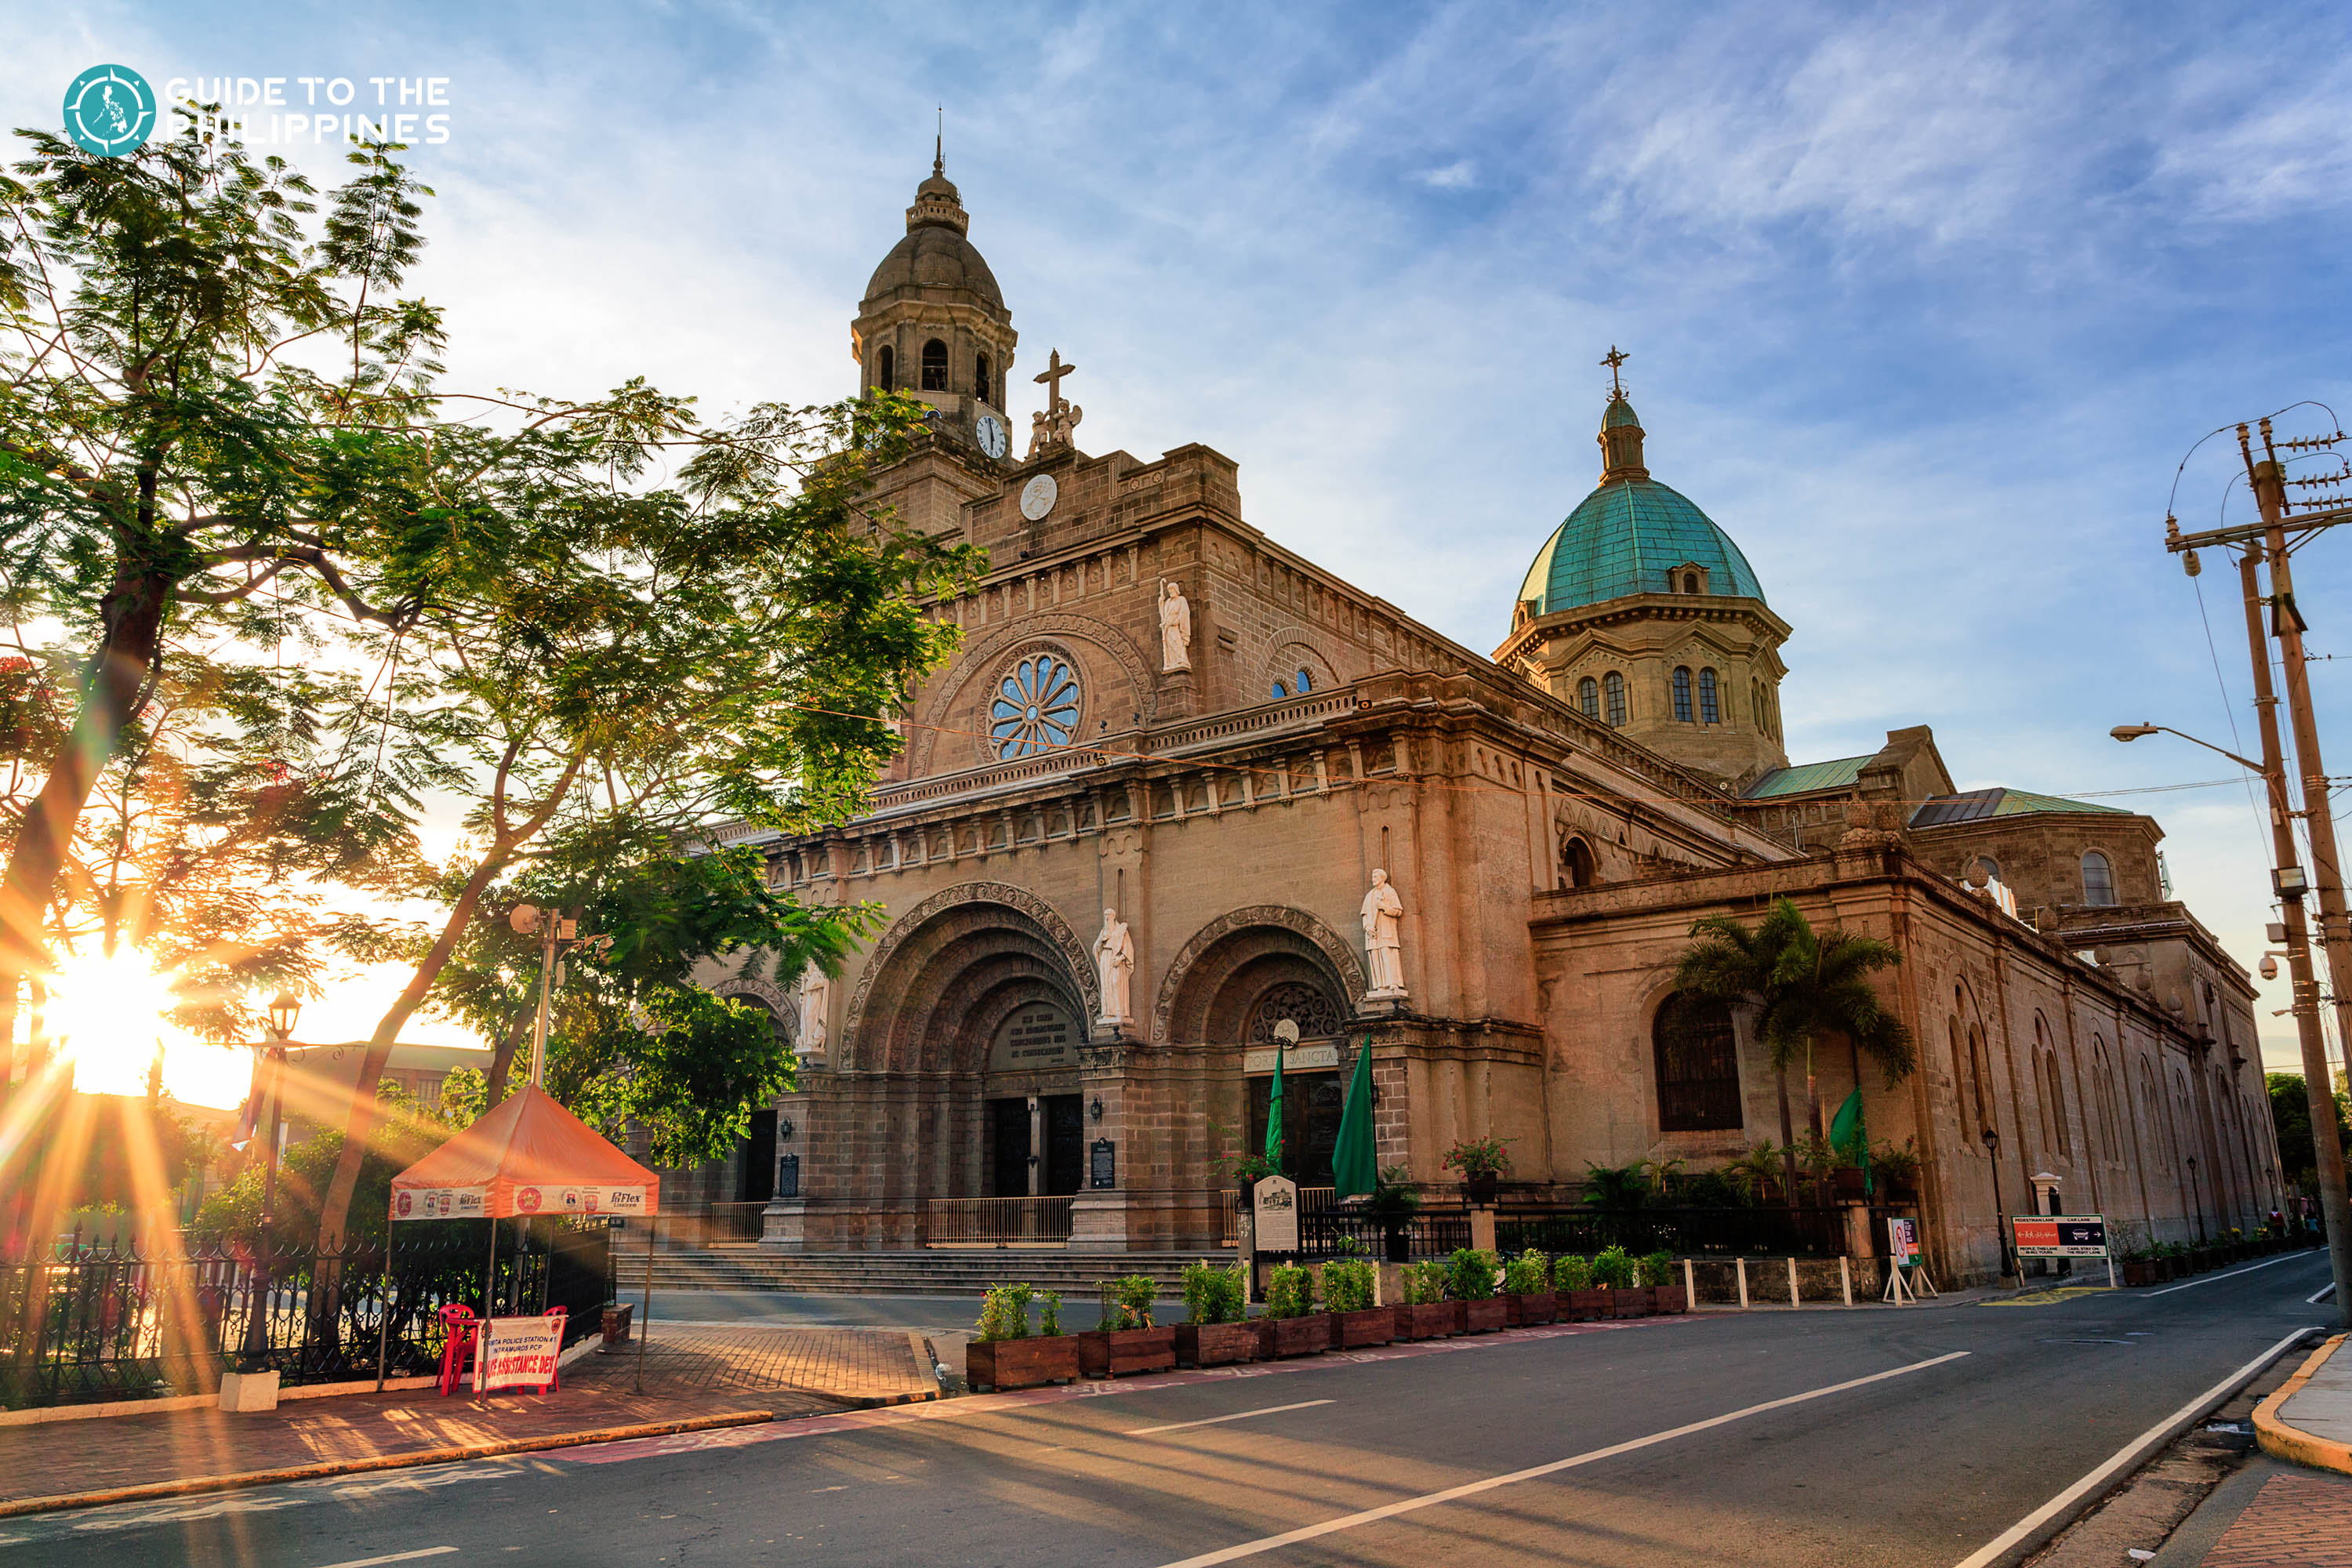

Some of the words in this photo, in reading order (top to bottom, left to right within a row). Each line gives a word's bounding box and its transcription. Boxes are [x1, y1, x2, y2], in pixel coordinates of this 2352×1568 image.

[1248, 1055, 1277, 1067] PORT
[1289, 1049, 1334, 1065] SANCTA
[494, 1345, 528, 1353] INTRAMUROS
[477, 1358, 497, 1380] PLICE
[496, 1355, 539, 1376] ASSISTANCE
